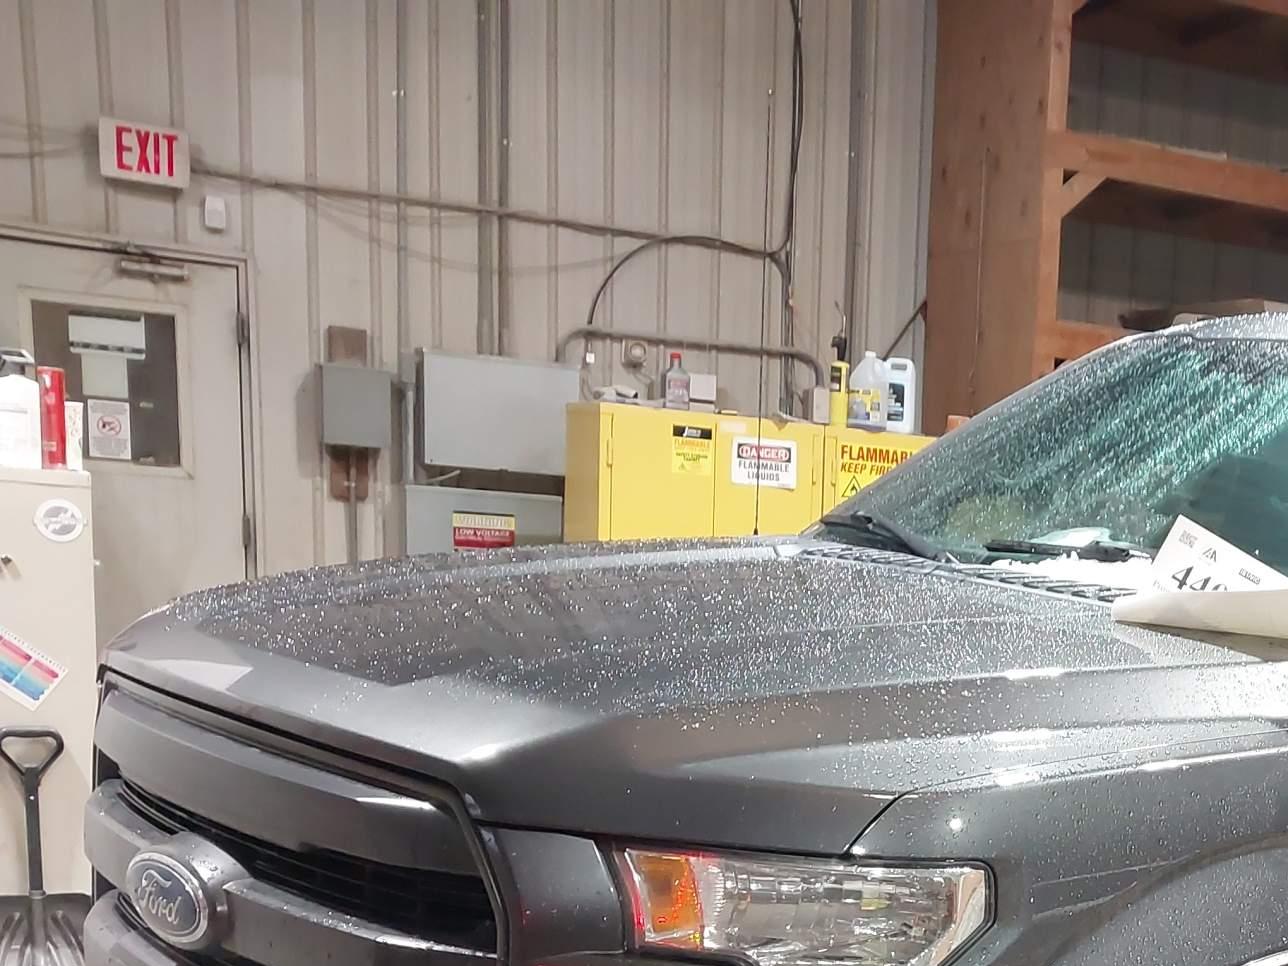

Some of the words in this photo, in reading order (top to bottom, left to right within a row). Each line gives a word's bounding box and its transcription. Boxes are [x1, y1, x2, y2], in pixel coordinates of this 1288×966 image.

[114, 125, 179, 177] EXIT
[742, 446, 786, 461] DANGER
[738, 459, 790, 472] FLAMMABLE
[840, 461, 867, 475] KEEP
[747, 471, 780, 481] LIQUIDS
[455, 527, 474, 536] LOW
[138, 868, 182, 924] Ford
